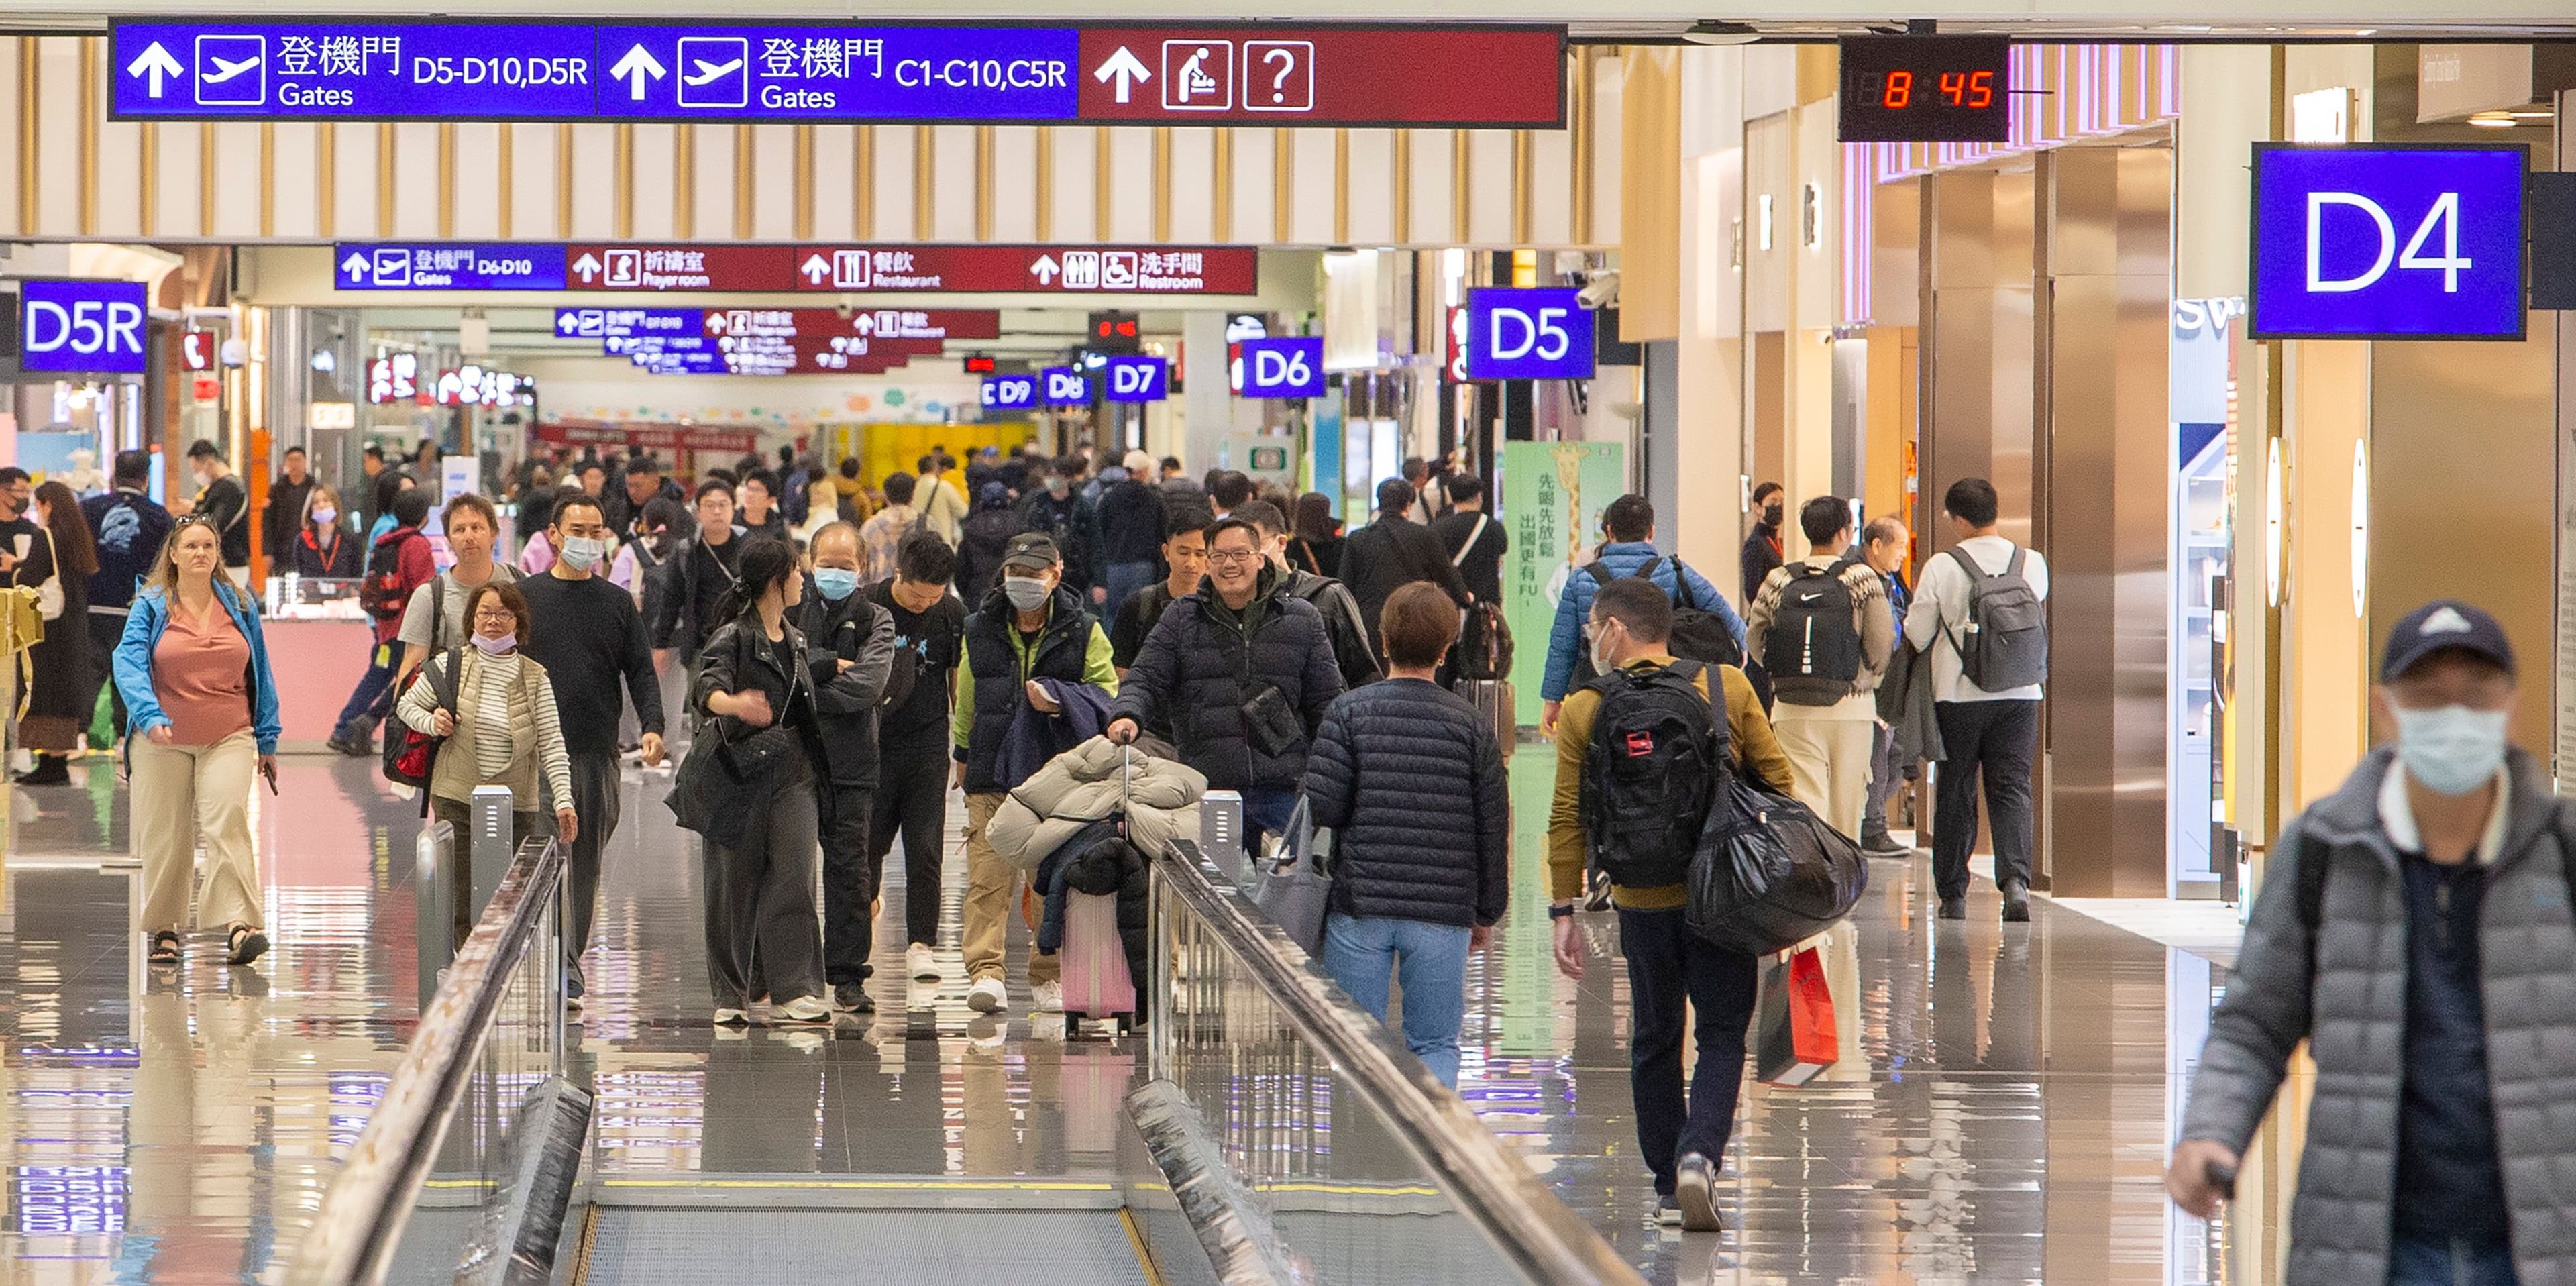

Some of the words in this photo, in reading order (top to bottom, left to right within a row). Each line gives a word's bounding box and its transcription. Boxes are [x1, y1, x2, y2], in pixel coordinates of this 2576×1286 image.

[276, 35, 401, 76] 登機門
[759, 38, 884, 79] 登機門
[413, 57, 588, 89] D5-D10,D5R
[895, 59, 1067, 92] C1-C10,C5R
[278, 82, 354, 107] Gates
[760, 85, 836, 109] Gates
[2306, 191, 2473, 293] D4
[414, 249, 475, 270] 登機門
[477, 258, 533, 276] D6-D10
[1140, 252, 1203, 275] 洗手間
[413, 271, 453, 286] Gates
[872, 272, 941, 288] Restaurant
[1139, 274, 1204, 290] Restroom
[25, 300, 143, 354] D5R
[1490, 307, 1570, 362] D5
[1114, 364, 1157, 394] D7
[1255, 349, 1311, 387] D6
[998, 380, 1032, 404] D9
